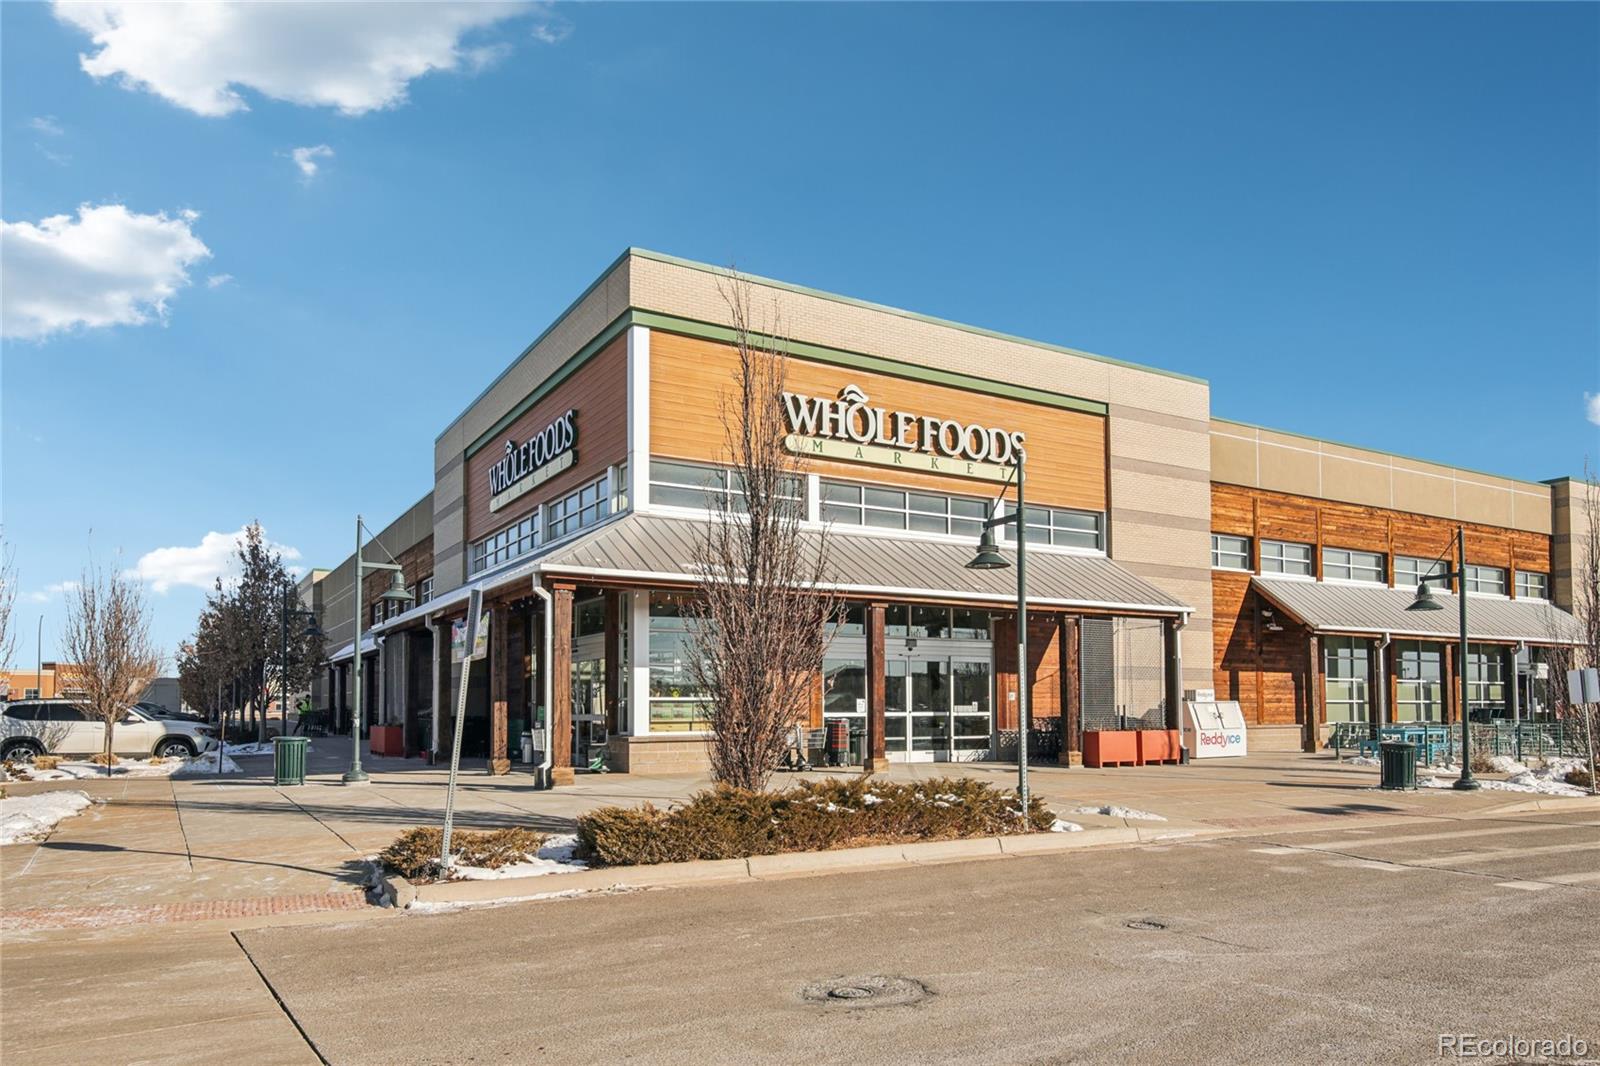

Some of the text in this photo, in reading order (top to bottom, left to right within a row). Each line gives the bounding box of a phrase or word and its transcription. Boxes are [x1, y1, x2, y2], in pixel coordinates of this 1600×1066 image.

[489, 409, 574, 497] WHOLE FOODS
[783, 392, 1026, 465] WHOLE FOODS
[812, 439, 1008, 479] MARKET
